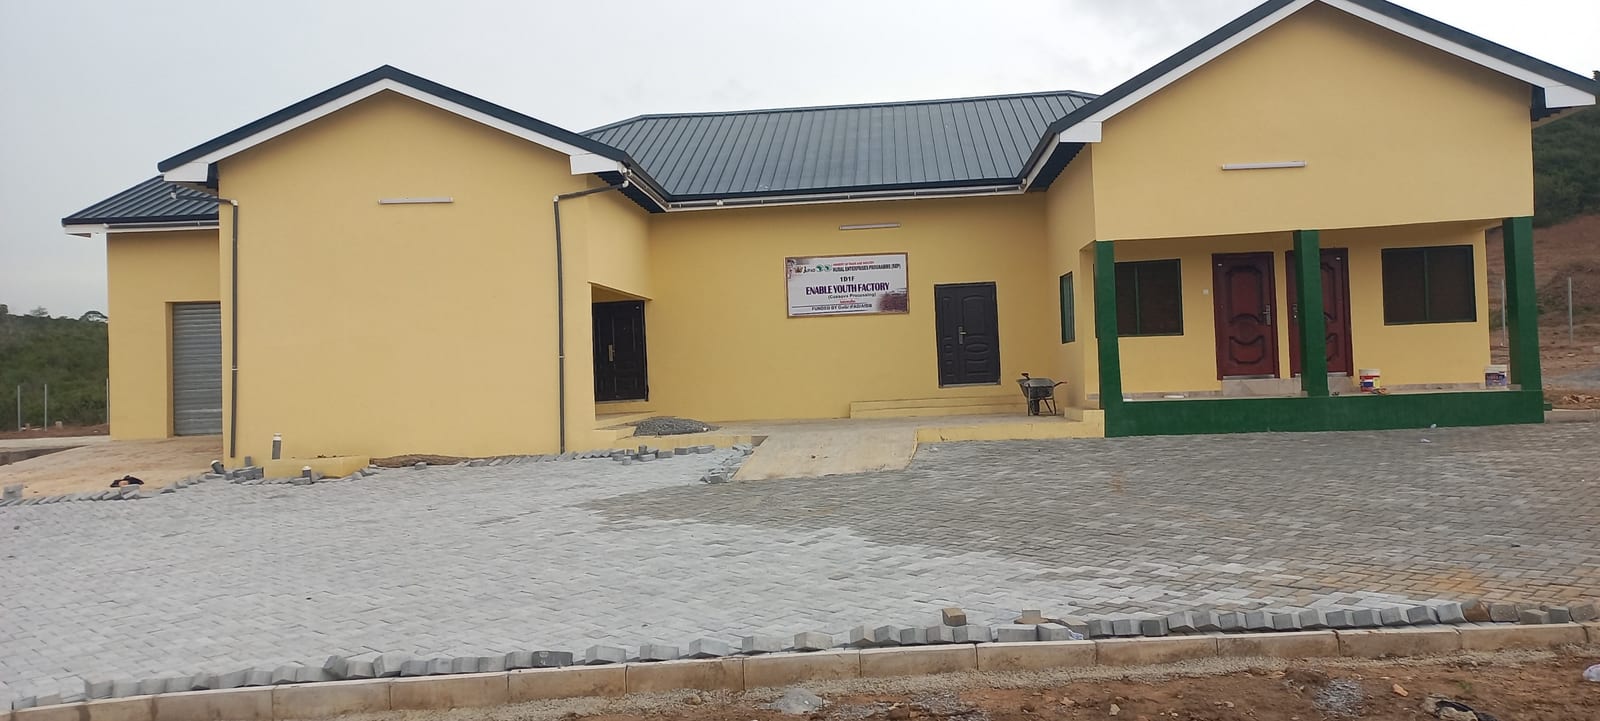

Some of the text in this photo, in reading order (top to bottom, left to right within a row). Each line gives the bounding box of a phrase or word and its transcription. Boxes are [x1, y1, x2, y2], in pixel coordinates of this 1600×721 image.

[806, 282, 889, 295] ENABLE YOUTH FACTORY
